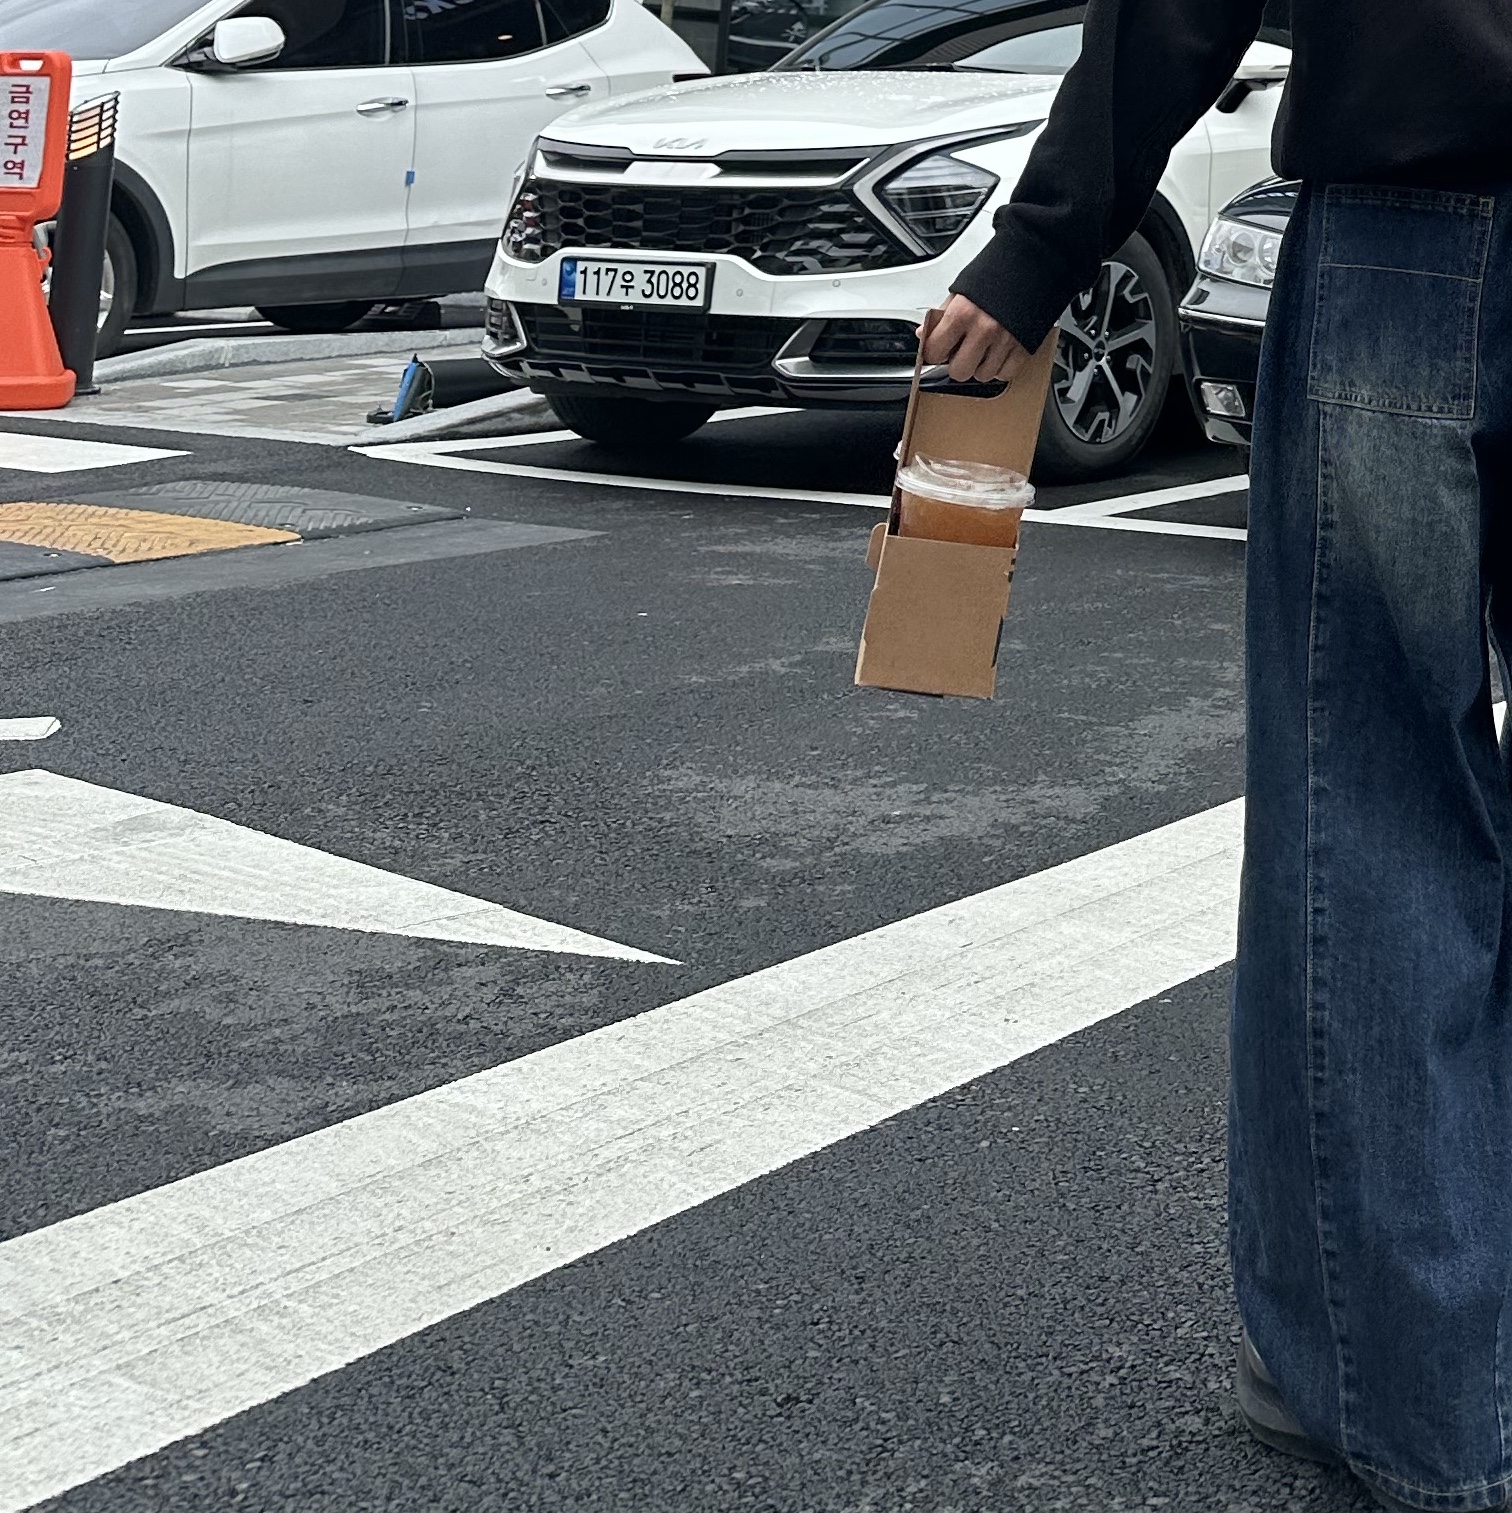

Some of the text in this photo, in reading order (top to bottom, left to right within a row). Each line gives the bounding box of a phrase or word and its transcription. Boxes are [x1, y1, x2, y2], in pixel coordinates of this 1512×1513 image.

[3, 83, 34, 181] 금연구역
[579, 265, 700, 301] 117우 3088
